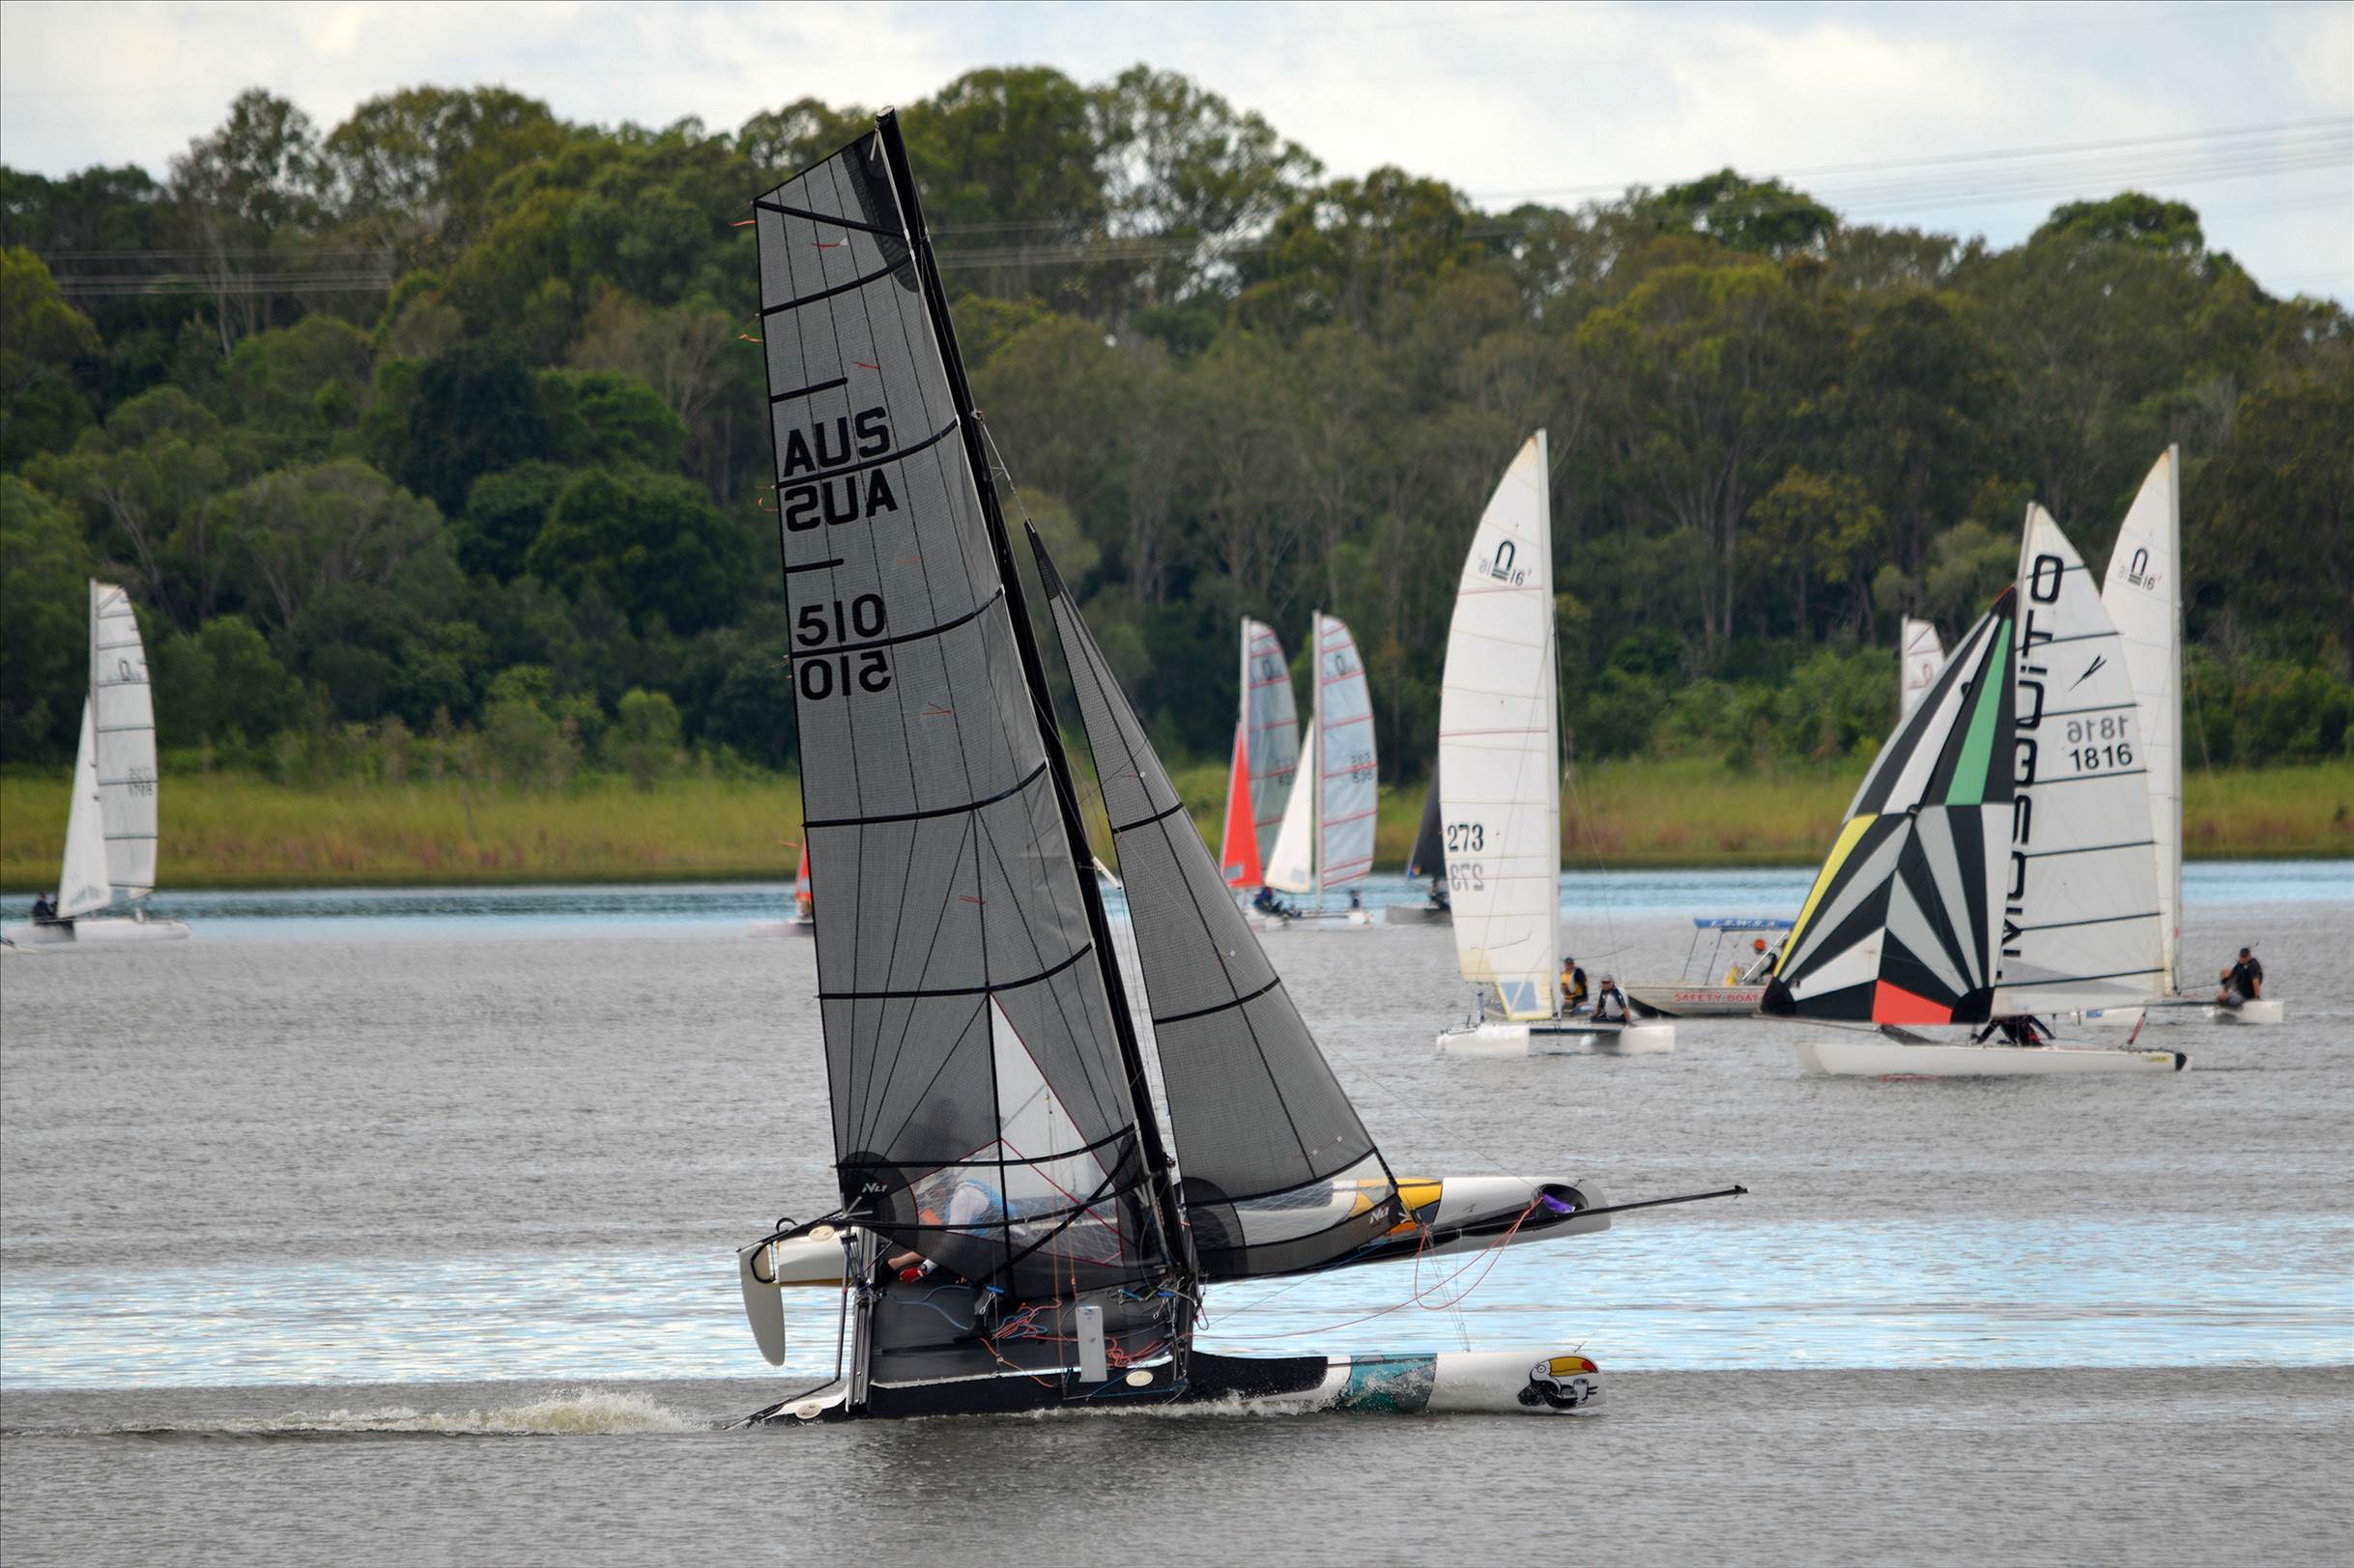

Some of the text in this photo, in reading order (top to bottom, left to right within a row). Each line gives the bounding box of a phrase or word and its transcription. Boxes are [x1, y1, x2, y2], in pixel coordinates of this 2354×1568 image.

[784, 407, 891, 477] AUS
[796, 593, 885, 646] 510
[2069, 743, 2133, 772] 1816
[1448, 823, 1483, 852] 273
[1674, 991, 1760, 1003] SAFETY BOAT
